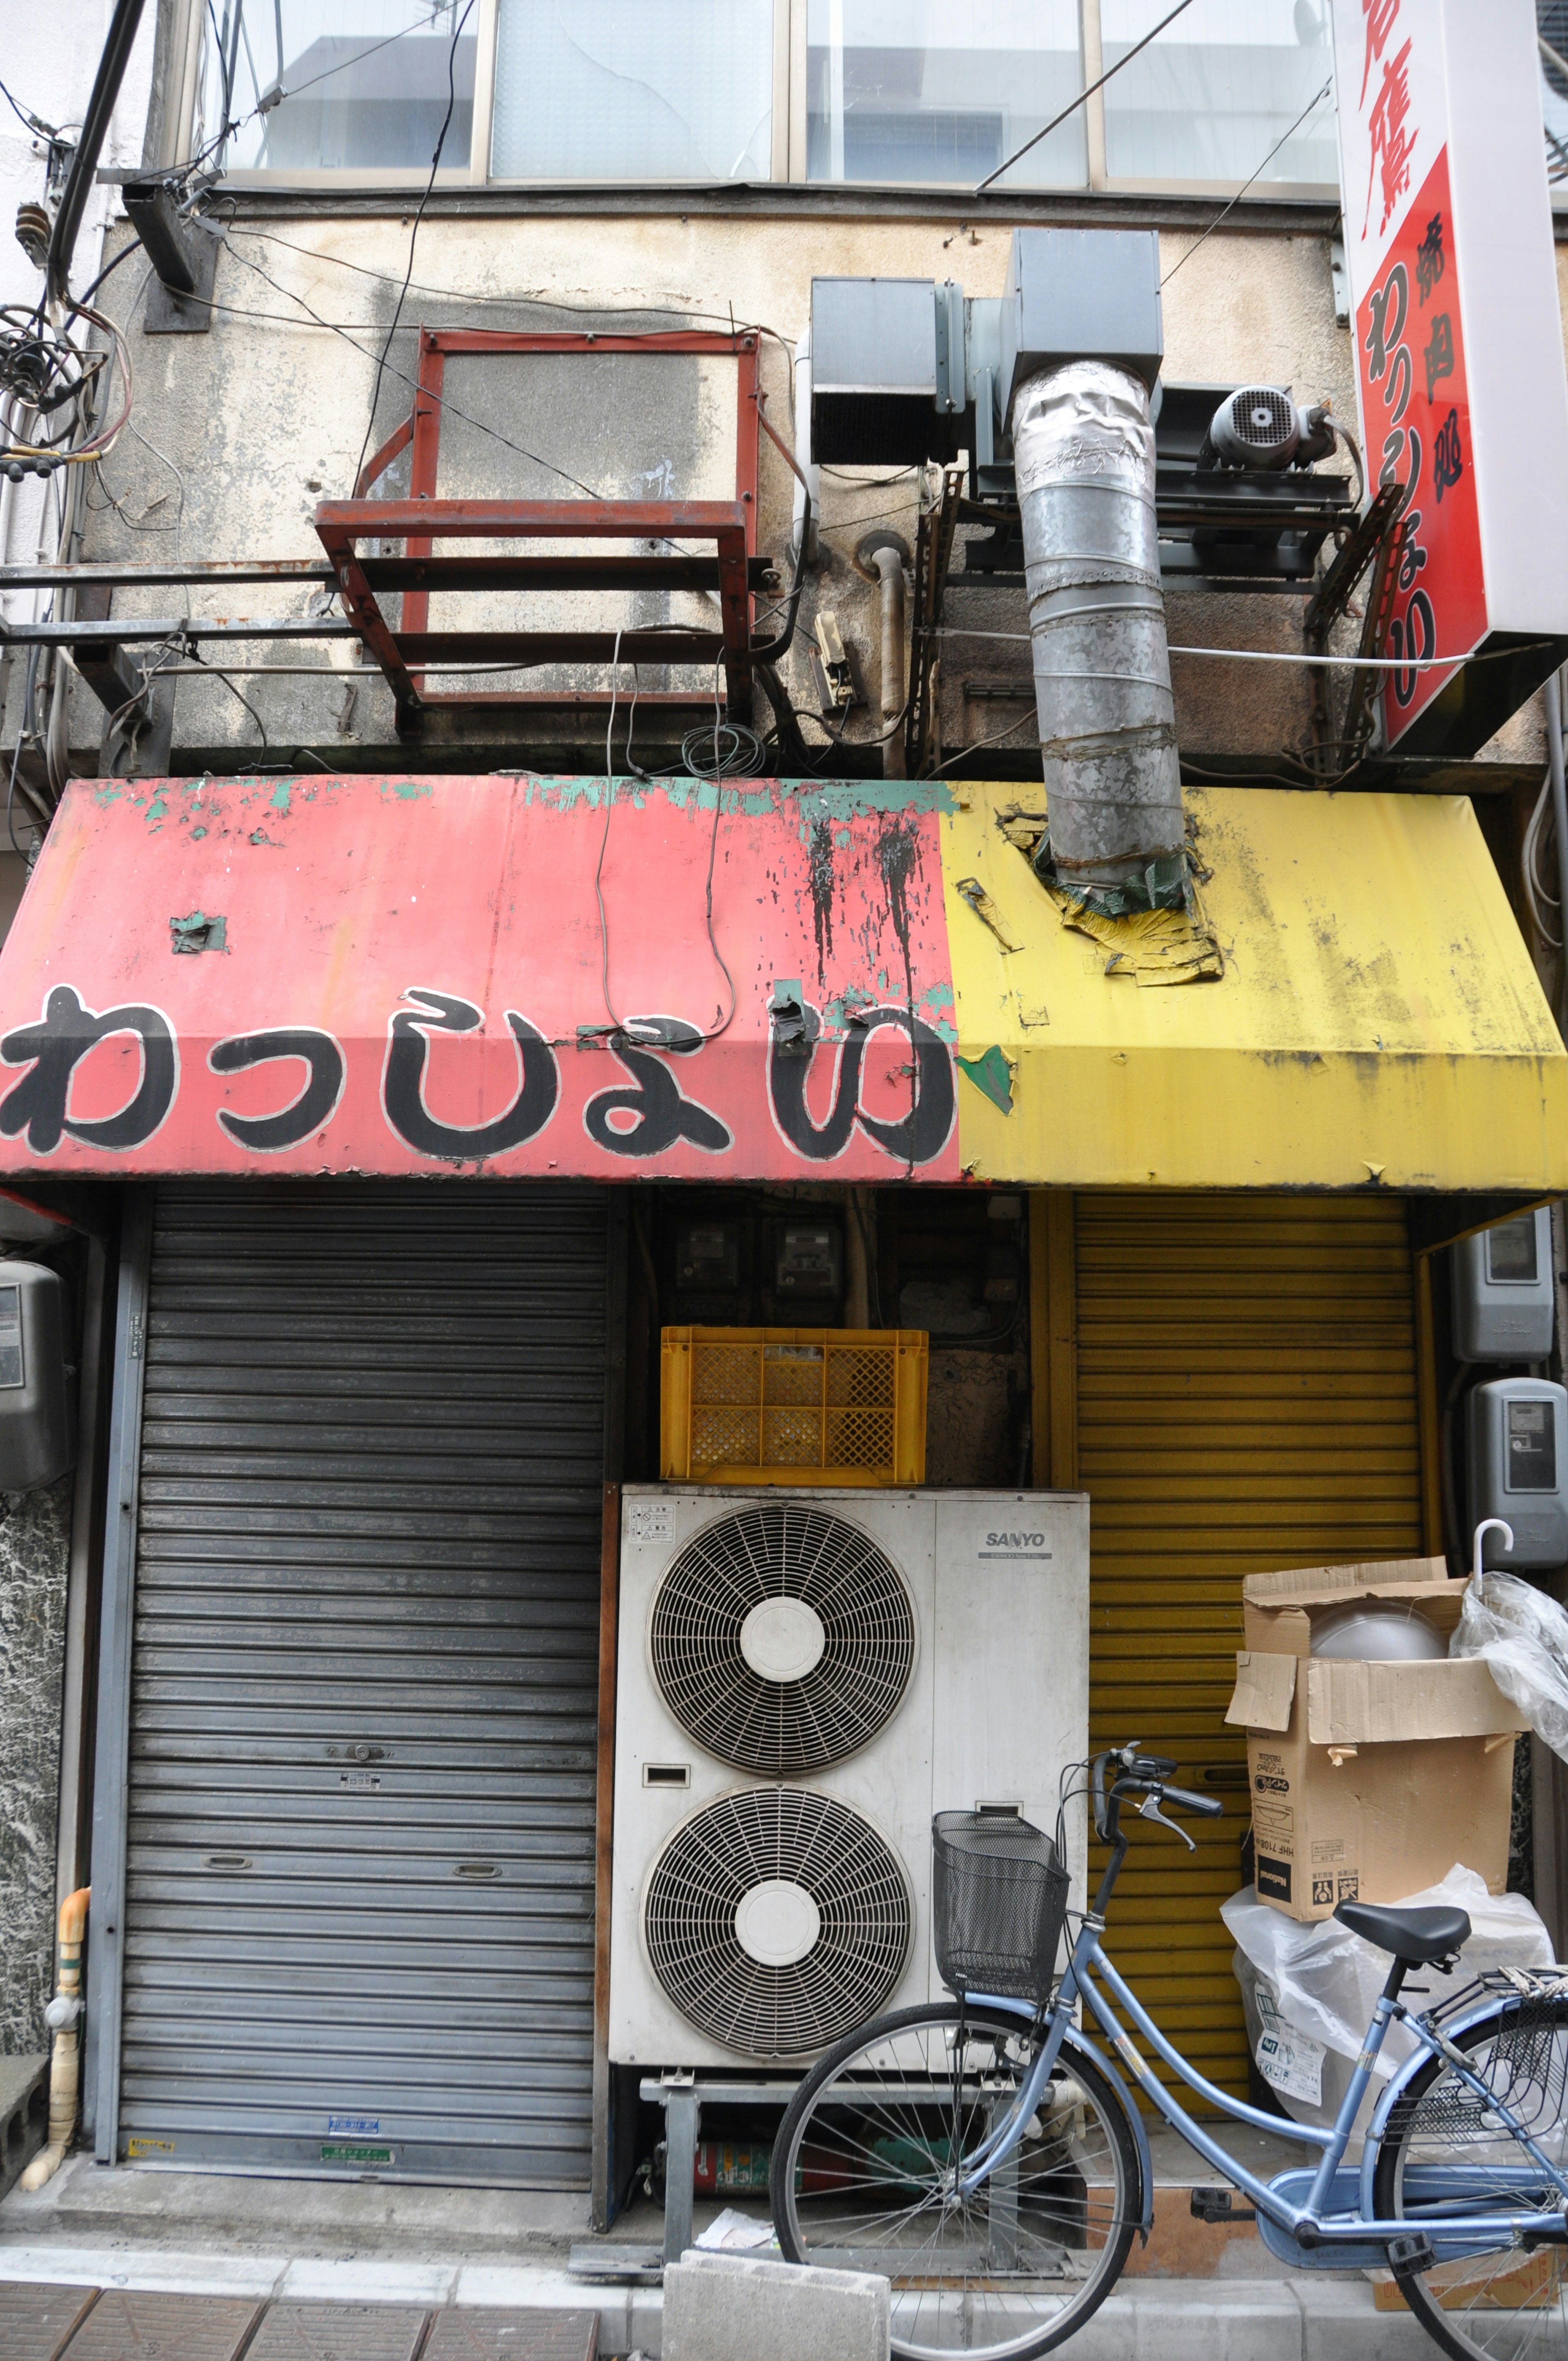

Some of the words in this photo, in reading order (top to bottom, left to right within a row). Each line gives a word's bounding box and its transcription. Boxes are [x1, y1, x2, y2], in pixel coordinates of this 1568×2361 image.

[985, 1533, 1045, 1547] SANYO
[1278, 1845, 1294, 1858] HHF
[1260, 1871, 1287, 1887] National
